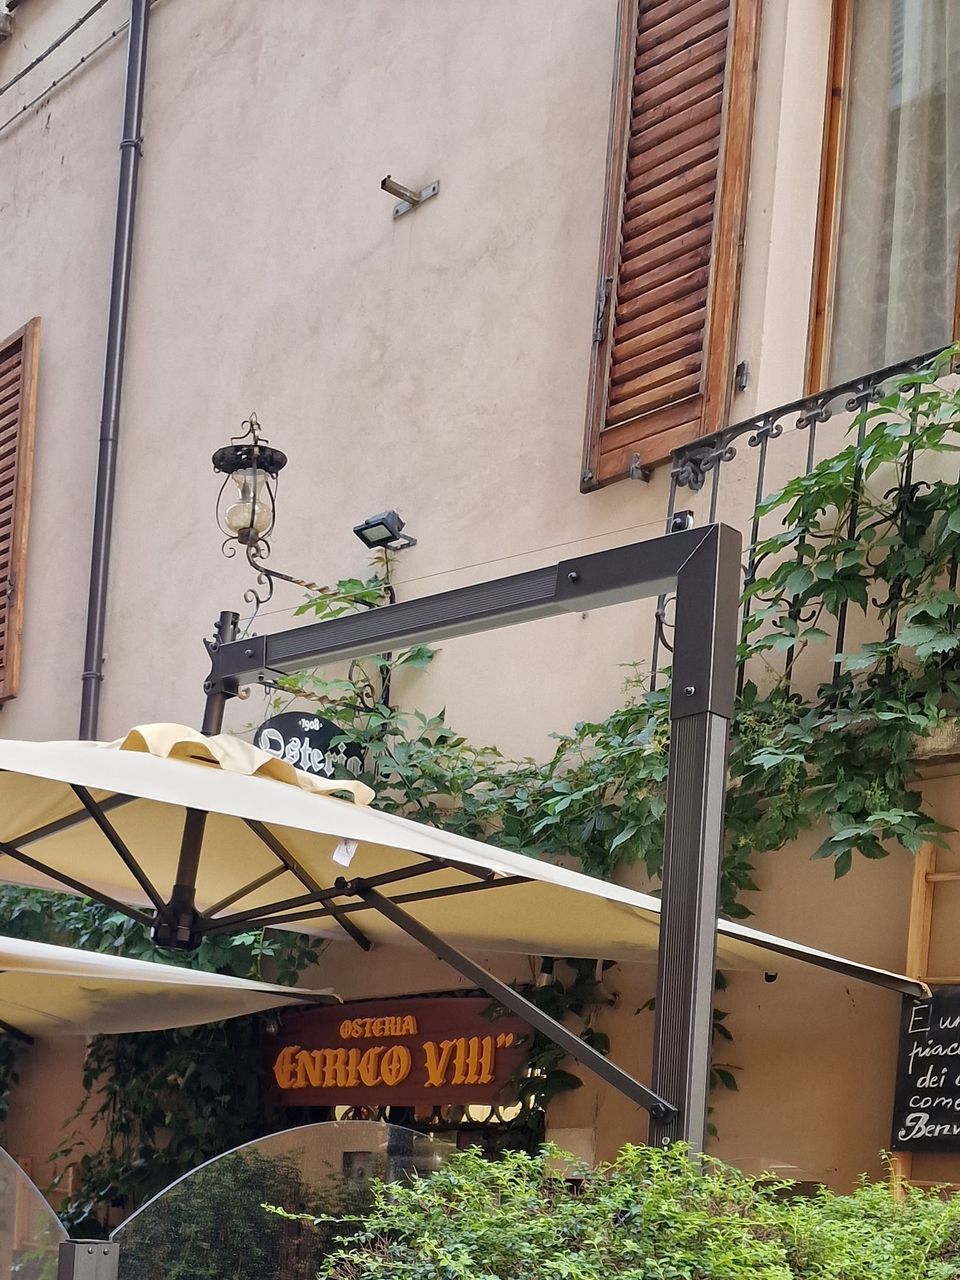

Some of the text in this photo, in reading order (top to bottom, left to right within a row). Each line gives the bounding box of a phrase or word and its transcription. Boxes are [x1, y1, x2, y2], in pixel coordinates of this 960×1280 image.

[340, 1015, 418, 1039] OSTERIA
[273, 1044, 412, 1089] ENRICO
[916, 1064, 948, 1089] dei
